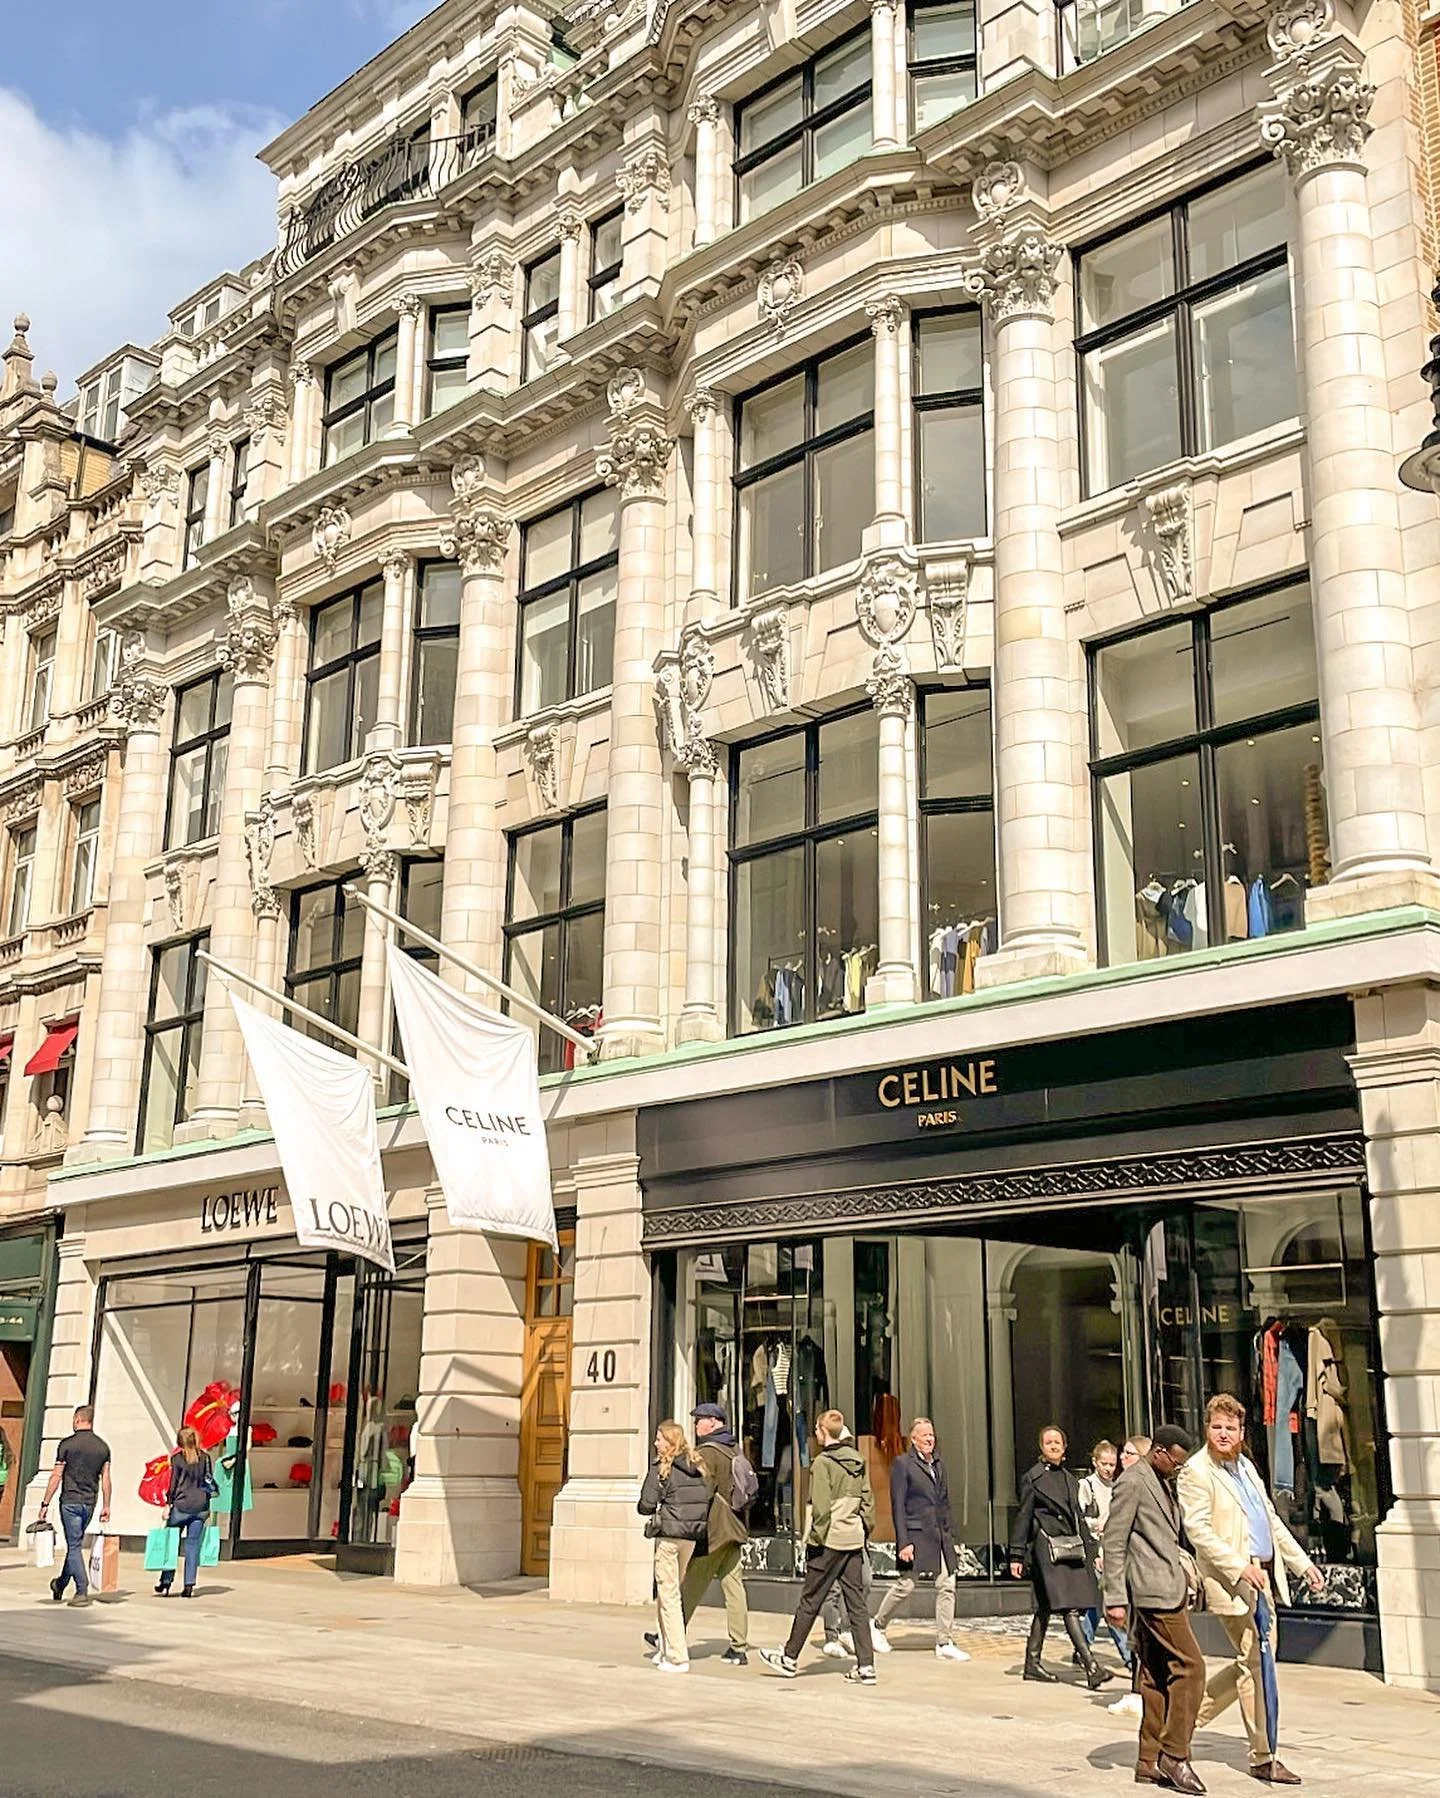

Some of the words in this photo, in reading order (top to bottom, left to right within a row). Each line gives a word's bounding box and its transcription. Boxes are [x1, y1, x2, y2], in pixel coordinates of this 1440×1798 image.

[878, 1060, 998, 1108] CELINE
[445, 1106, 531, 1136] CELINE
[918, 1110, 957, 1127] PARIS
[201, 1186, 279, 1233] LOEWE
[1160, 1304, 1230, 1326] CELNE
[587, 1349, 616, 1384] 40
